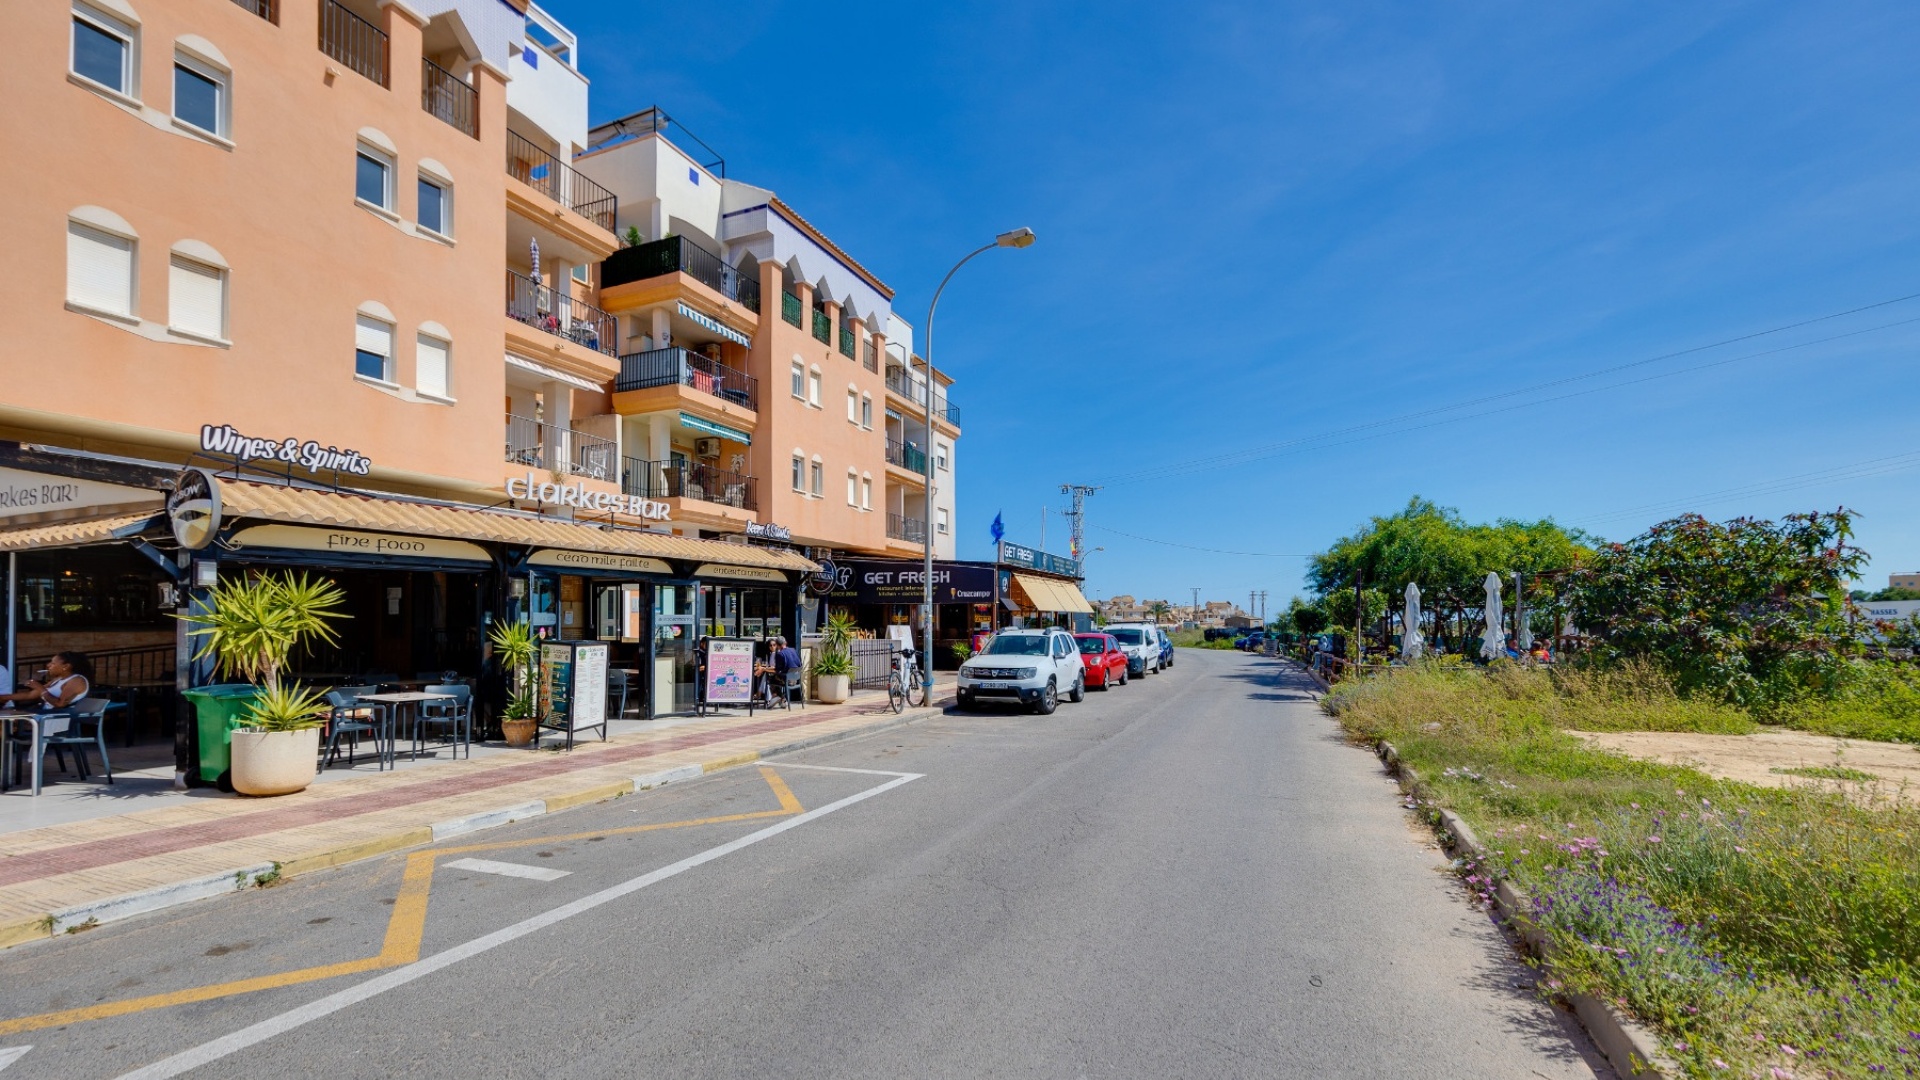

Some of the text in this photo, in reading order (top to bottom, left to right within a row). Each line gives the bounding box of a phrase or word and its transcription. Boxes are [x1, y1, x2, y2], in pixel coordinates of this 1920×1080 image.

[202, 425, 371, 475] Wines & Spirits
[1004, 545, 1016, 558] GET
[864, 572, 893, 584] GET
[957, 589, 991, 598] Cruzcampo
